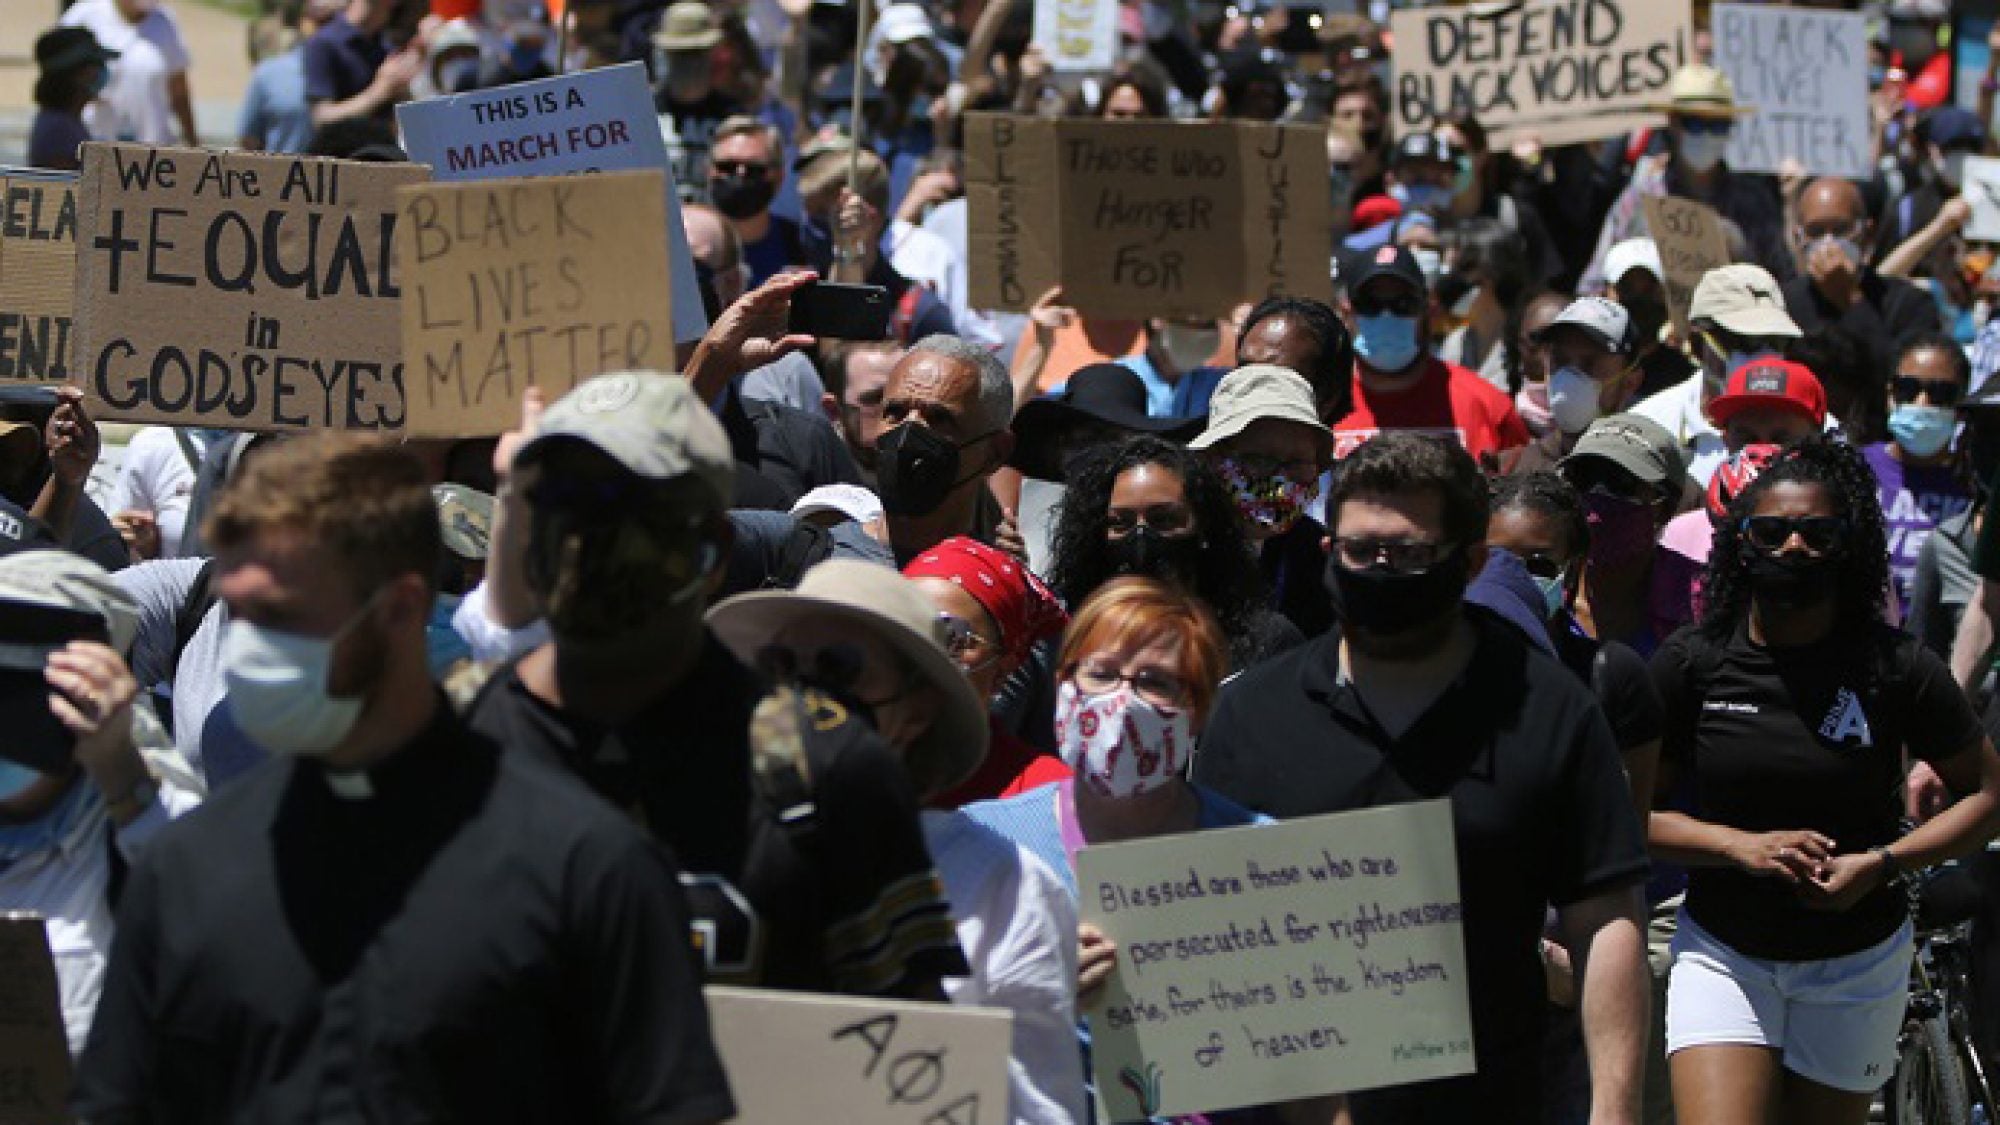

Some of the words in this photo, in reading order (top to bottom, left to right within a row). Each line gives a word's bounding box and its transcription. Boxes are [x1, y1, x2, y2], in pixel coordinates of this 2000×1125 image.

[1427, 0, 1623, 67] DEFEND
[1722, 13, 1851, 67] BLACK
[470, 96, 529, 125] THIS
[532, 90, 559, 115] IS
[564, 86, 586, 110] A
[1399, 62, 1518, 124] BLACK
[446, 132, 559, 172] MARCH
[565, 120, 630, 154] FOR
[1063, 137, 1159, 175] THOSE
[1736, 113, 1862, 174] ATTER
[113, 147, 177, 192] We
[193, 149, 260, 199] Are
[279, 160, 339, 205] All
[0, 186, 76, 242] ELA
[407, 185, 593, 261] BLACK
[146, 206, 402, 301] EQUAL
[417, 255, 586, 332] LIVES
[244, 311, 281, 350] in
[424, 318, 651, 408] MATTER
[1099, 864, 1206, 913] Blessed
[1245, 858, 1301, 890] those
[1306, 848, 1355, 881] who
[1358, 856, 1399, 878] are
[1128, 916, 1280, 977] persecuted
[1284, 911, 1320, 944] for
[1167, 985, 1205, 1016] for
[1209, 977, 1277, 1011] theirs
[1283, 973, 1307, 1000] is
[1312, 960, 1353, 996] the
[1193, 1030, 1225, 1068] of
[1240, 1023, 1348, 1060] heaven
